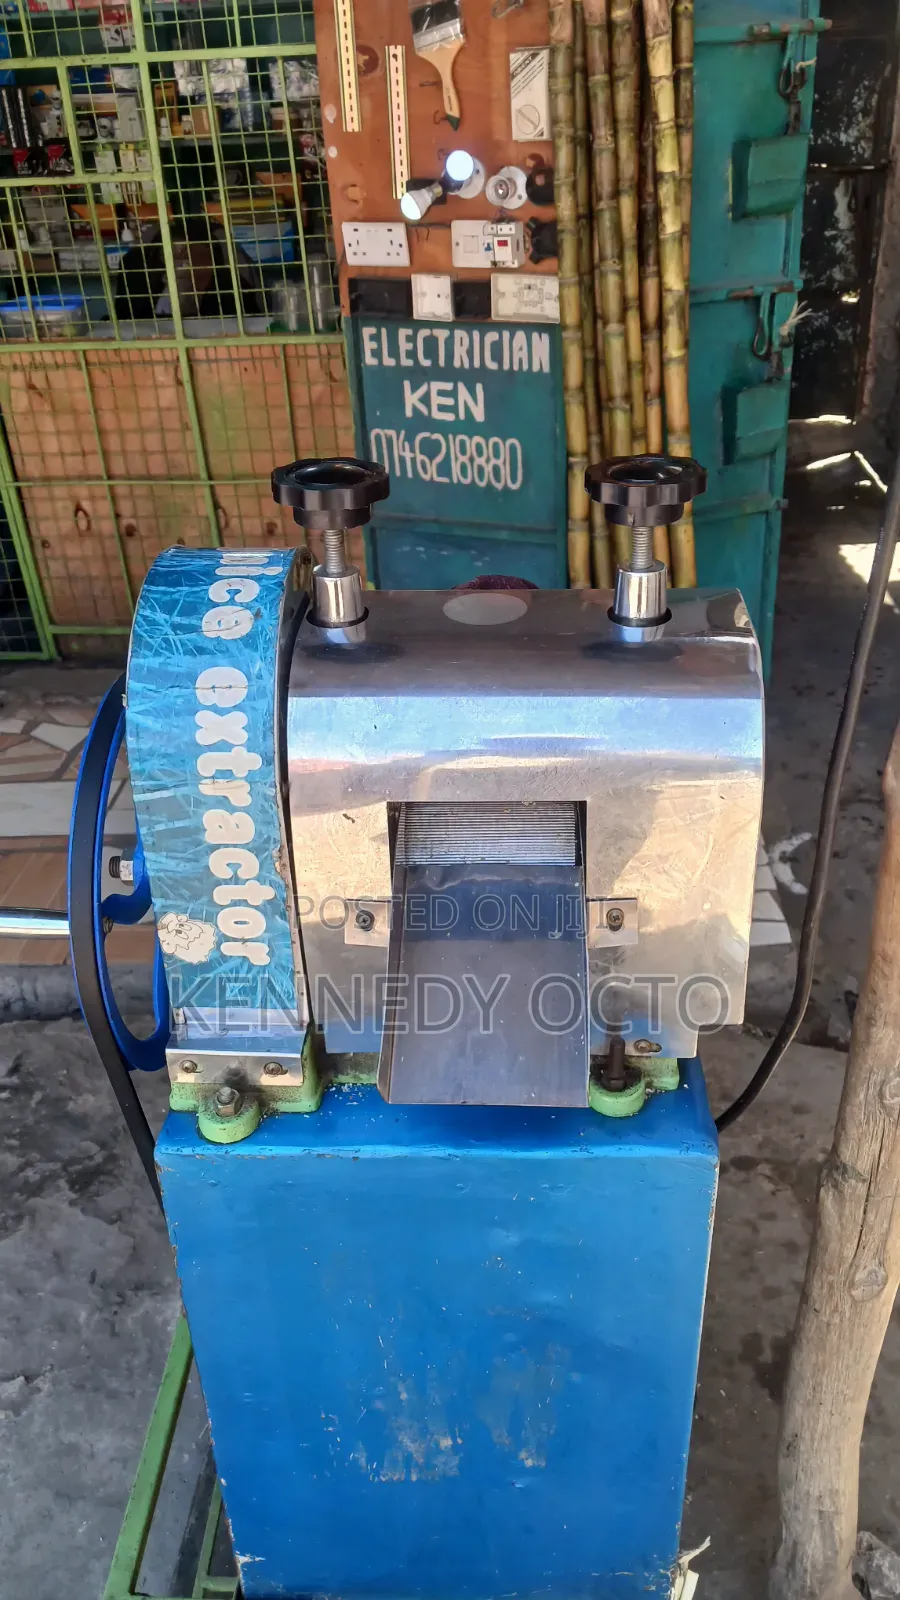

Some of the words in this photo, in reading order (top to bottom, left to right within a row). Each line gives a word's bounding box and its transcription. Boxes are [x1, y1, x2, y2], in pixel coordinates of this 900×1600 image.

[362, 326, 550, 373] ELECTRICIAN
[403, 380, 485, 422] KEN
[195, 666, 276, 966] extractor
